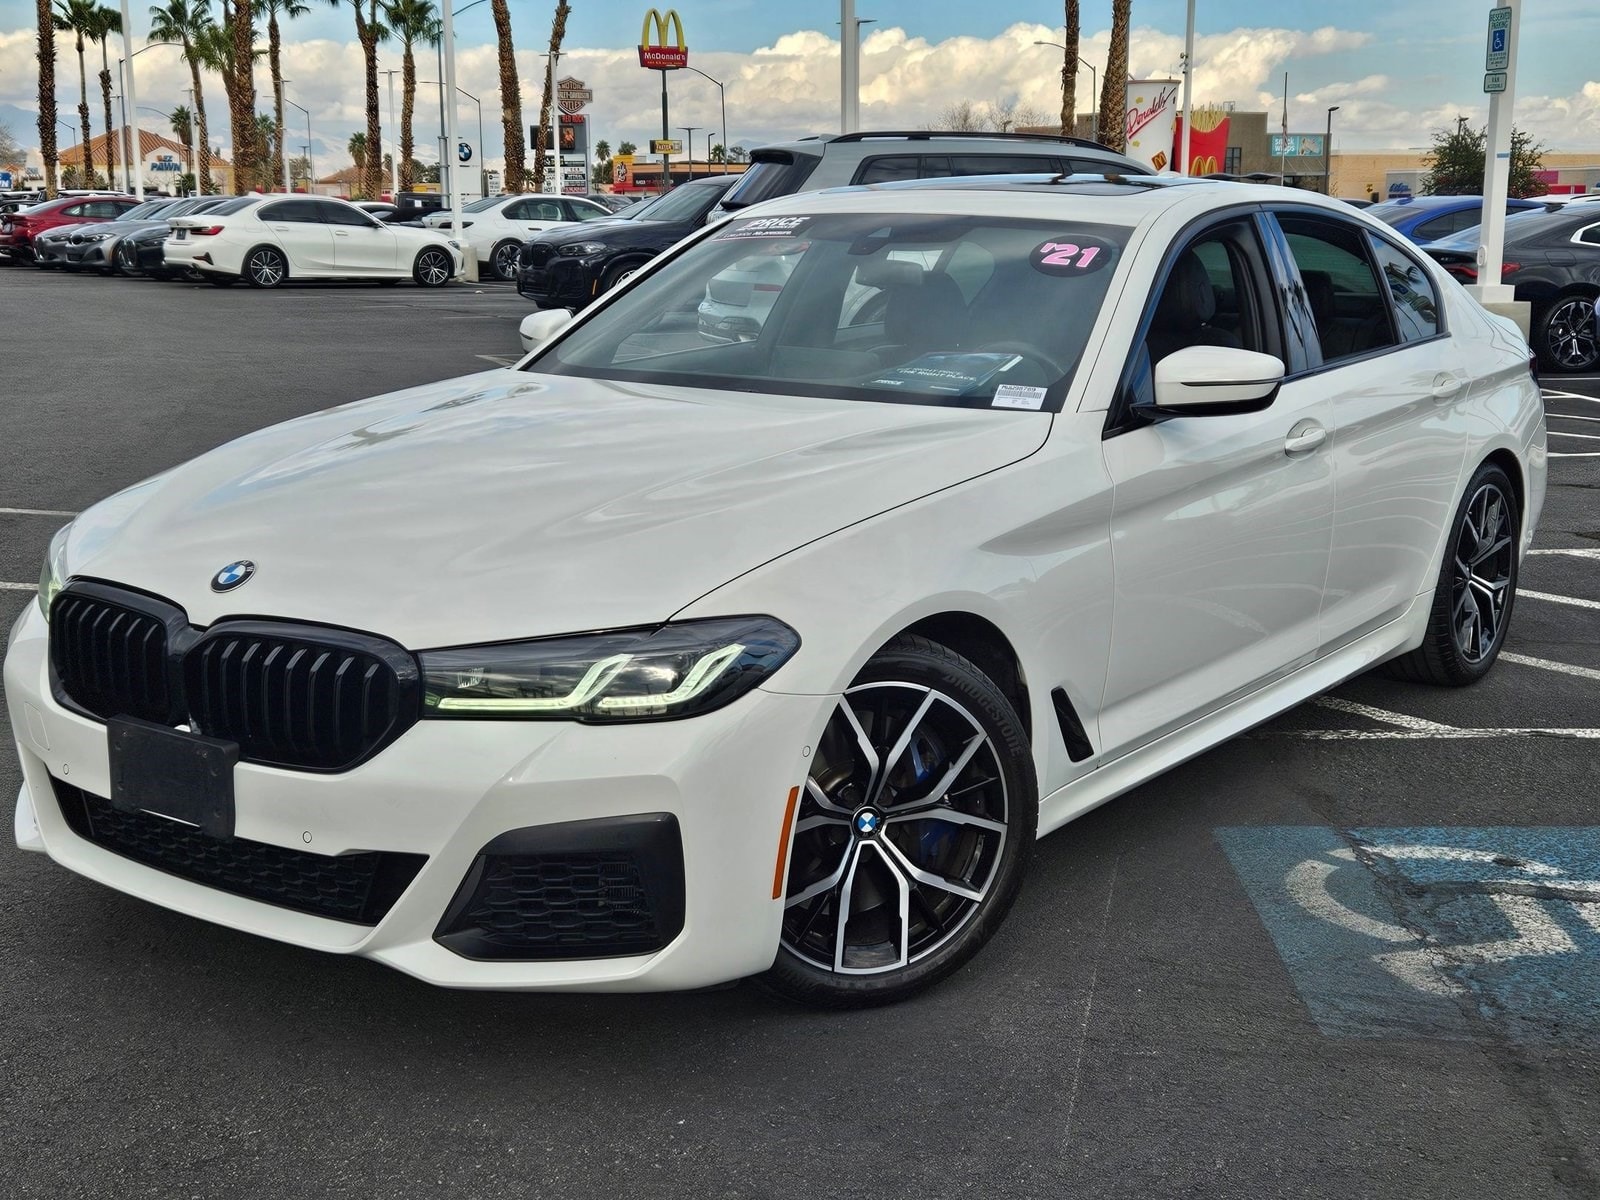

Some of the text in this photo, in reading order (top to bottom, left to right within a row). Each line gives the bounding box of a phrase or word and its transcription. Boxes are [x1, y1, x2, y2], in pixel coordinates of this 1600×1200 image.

[1491, 21, 1509, 29] PARKING
[644, 52, 686, 61] McDonald's
[1126, 86, 1176, 134] Donald's
[1275, 137, 1295, 145] snck
[151, 163, 182, 171] PAWN
[1040, 242, 1100, 268] '21
[944, 671, 1022, 757] BRIDGESTONE
